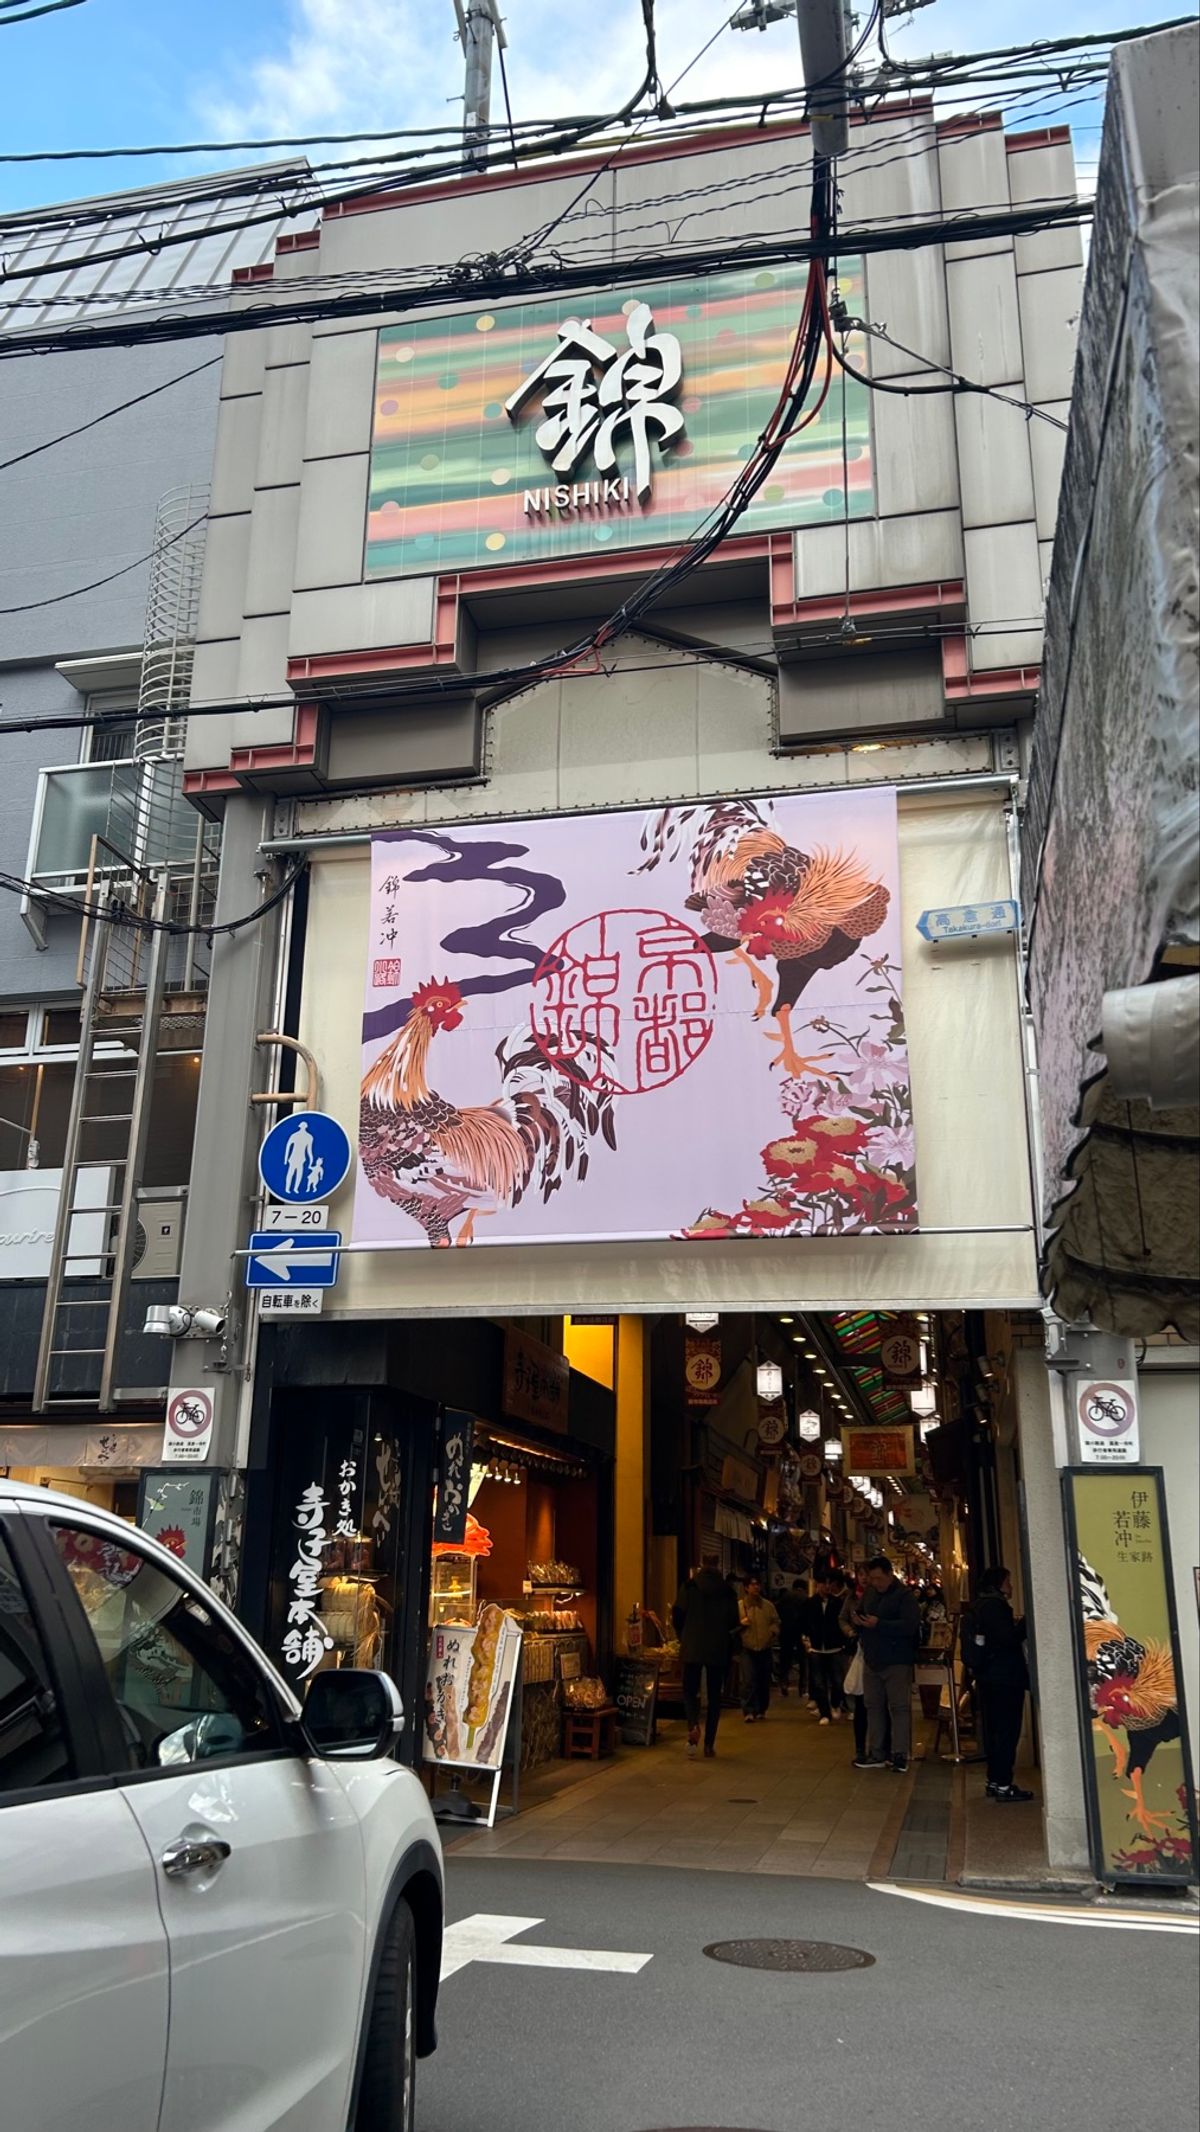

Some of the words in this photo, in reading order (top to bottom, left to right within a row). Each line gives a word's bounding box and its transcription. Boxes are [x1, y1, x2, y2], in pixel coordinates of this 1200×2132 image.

[505, 303, 685, 500] 錦
[523, 476, 631, 516] NISHIKI
[379, 875, 400, 951] 錦若冲
[262, 1295, 319, 1308] 自転車を除く
[888, 1340, 911, 1369] 錦
[333, 1459, 357, 1537] おかき処
[1131, 1490, 1152, 1529] 伊藤
[1113, 1510, 1132, 1548] 若冲
[281, 1481, 334, 1680] 寺子屋本舗
[617, 1694, 648, 1709] OPEN
